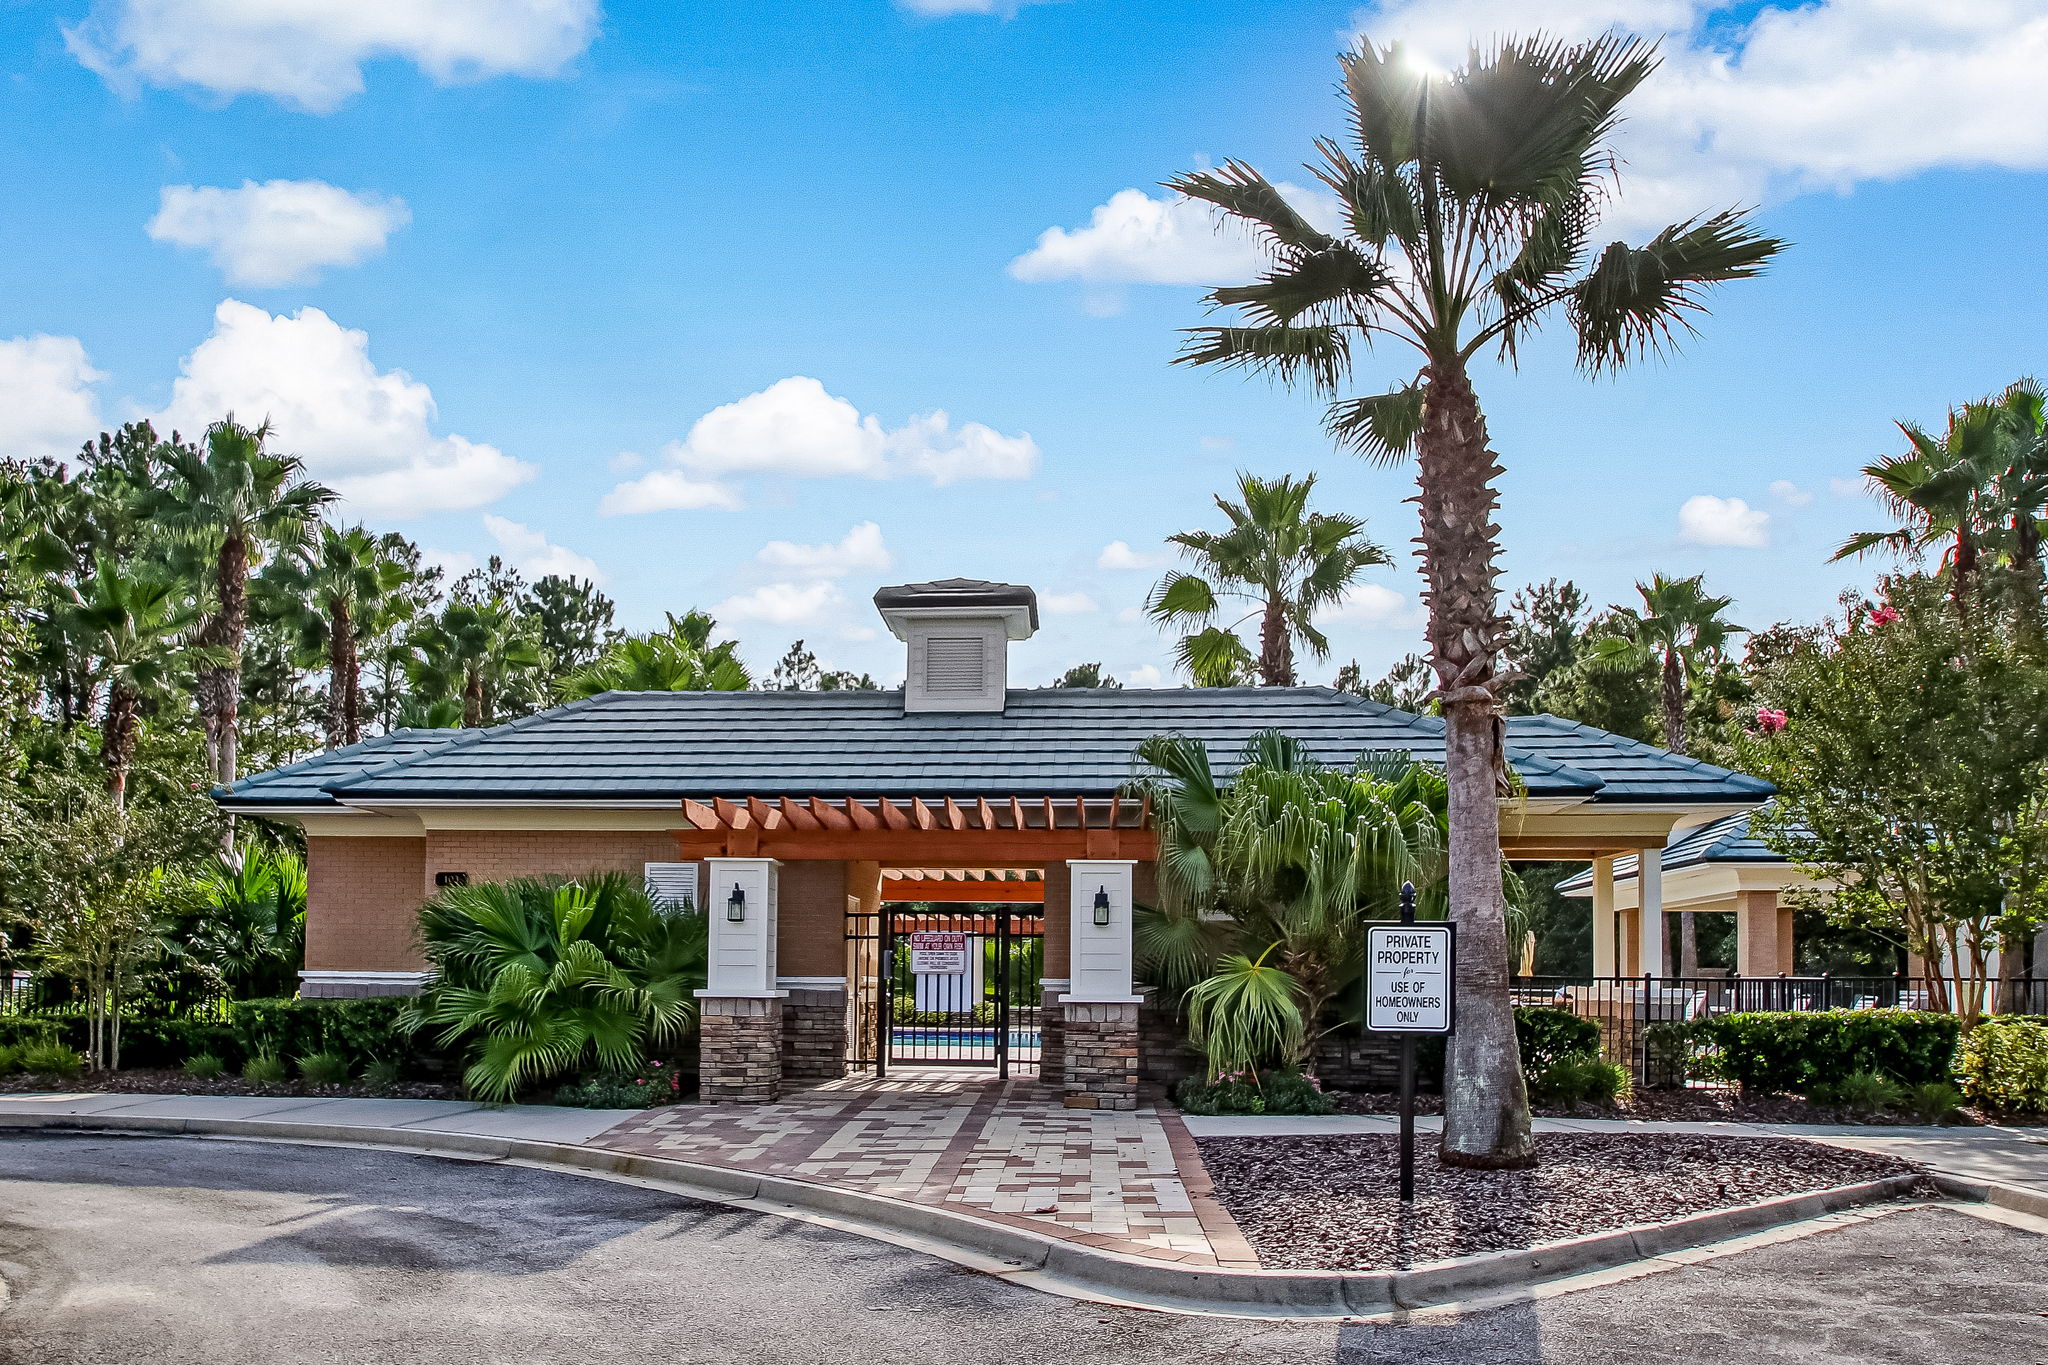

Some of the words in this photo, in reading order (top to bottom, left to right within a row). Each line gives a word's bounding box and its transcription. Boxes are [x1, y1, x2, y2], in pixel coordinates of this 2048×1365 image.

[1386, 935, 1432, 948] PRIVATE
[1377, 950, 1440, 964] PROPERTY
[1403, 966, 1414, 979] for
[1391, 981, 1409, 993] USE
[1412, 981, 1426, 993] OF
[1375, 995, 1441, 1009] HOMEOWNERS
[1396, 1010, 1419, 1023] ONLY
